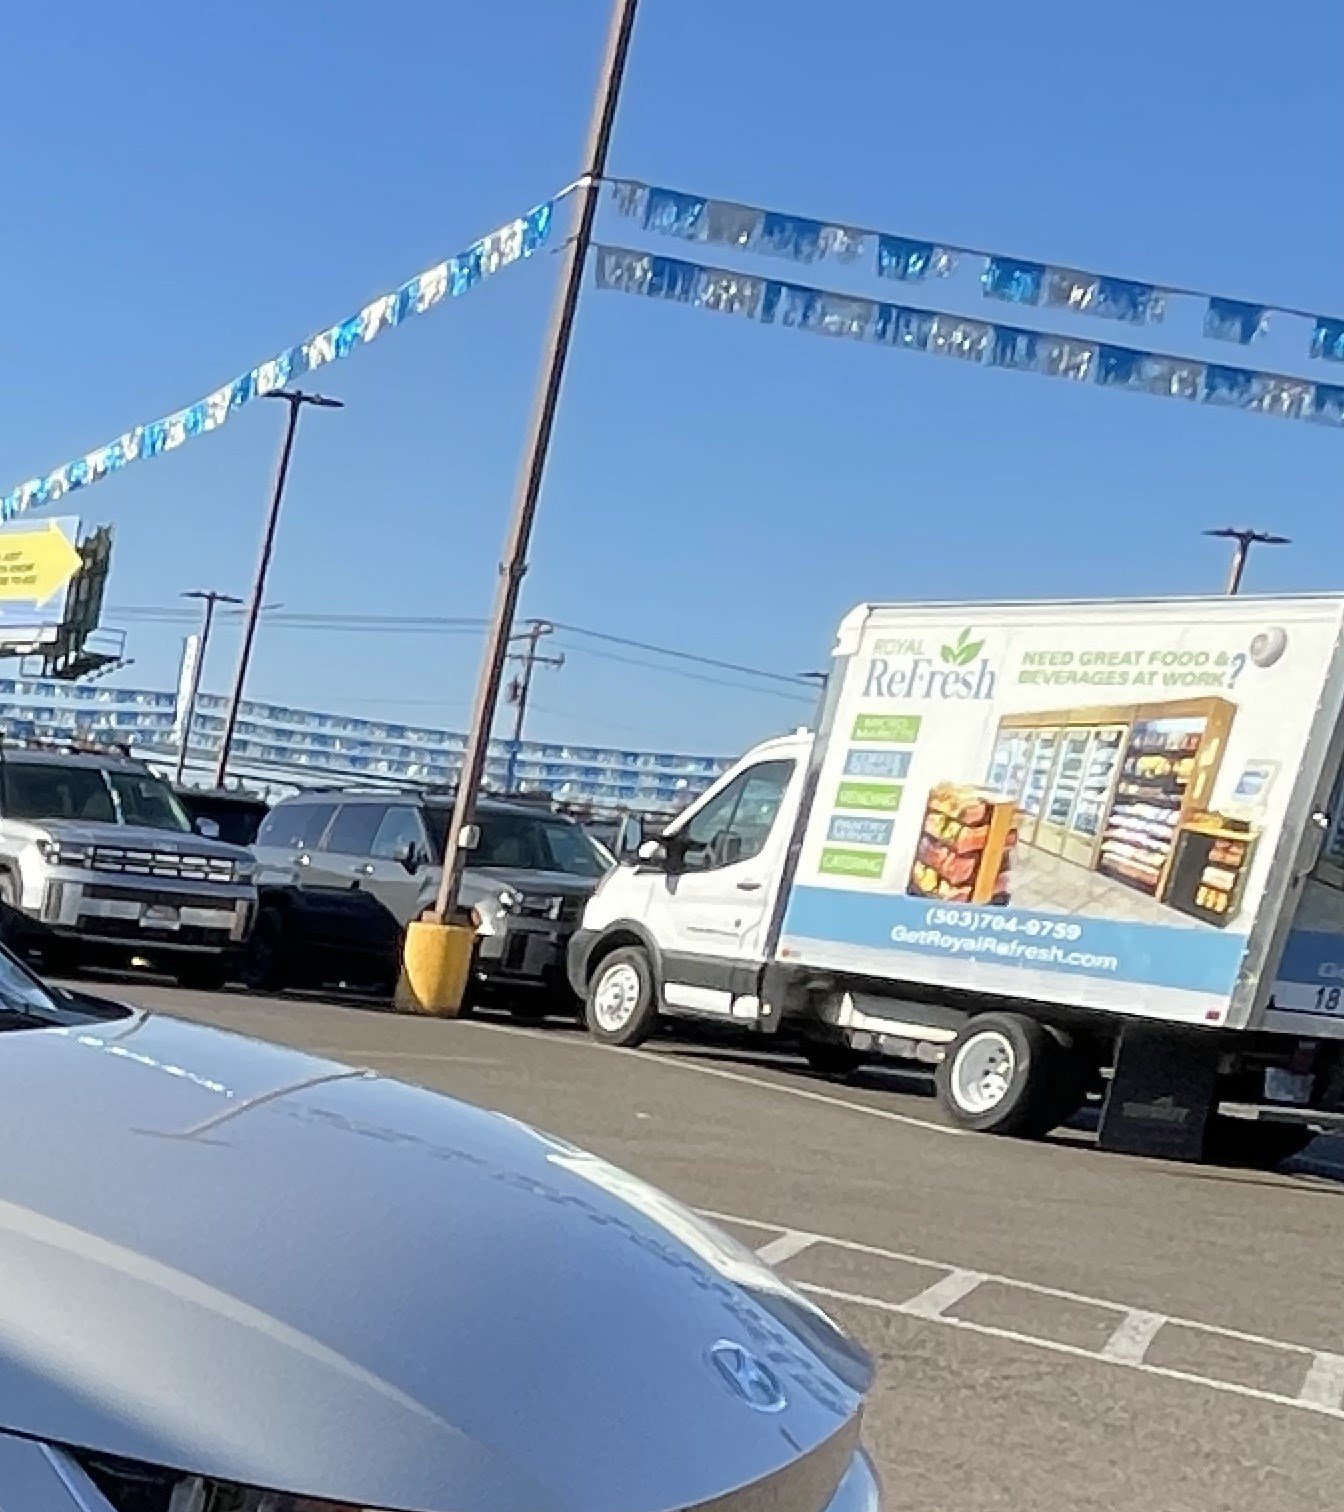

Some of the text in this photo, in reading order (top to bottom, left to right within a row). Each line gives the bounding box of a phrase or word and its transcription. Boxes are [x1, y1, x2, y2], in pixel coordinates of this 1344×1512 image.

[873, 638, 926, 656] ROYAL
[1021, 650, 1074, 666] NEED
[1078, 650, 1145, 666] GREAT
[1147, 650, 1210, 666] FOOD
[1018, 670, 1130, 686] BEVERAGES
[1131, 670, 1159, 686] AT
[890, 924, 1118, 971] GetRoyalRefresh.com
